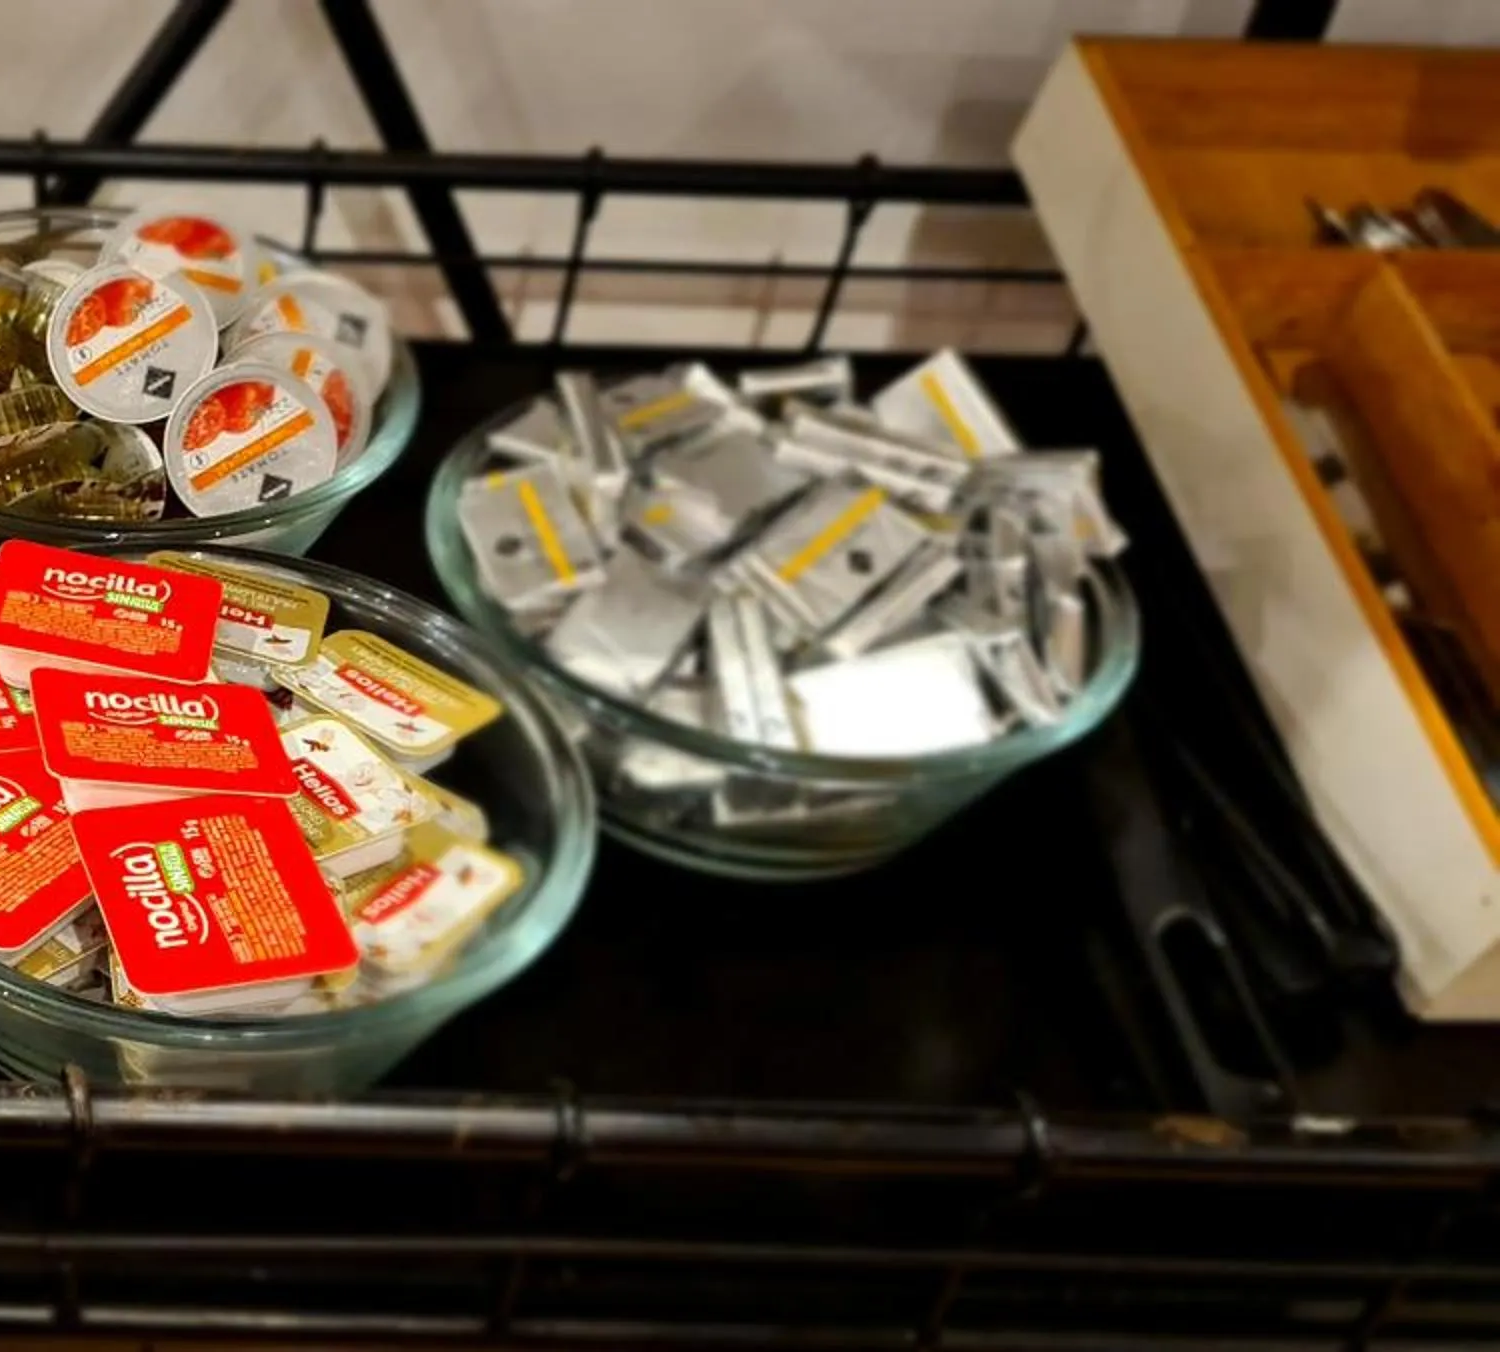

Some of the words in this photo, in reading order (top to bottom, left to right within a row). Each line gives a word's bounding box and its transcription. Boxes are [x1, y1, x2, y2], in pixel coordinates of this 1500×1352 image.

[43, 567, 157, 597] nocilla
[220, 605, 265, 626] Hel
[85, 691, 205, 717] nocilla
[345, 668, 418, 716] Helios
[292, 763, 349, 816] Helios
[122, 852, 188, 949] nocilla
[361, 868, 433, 917] Helios
